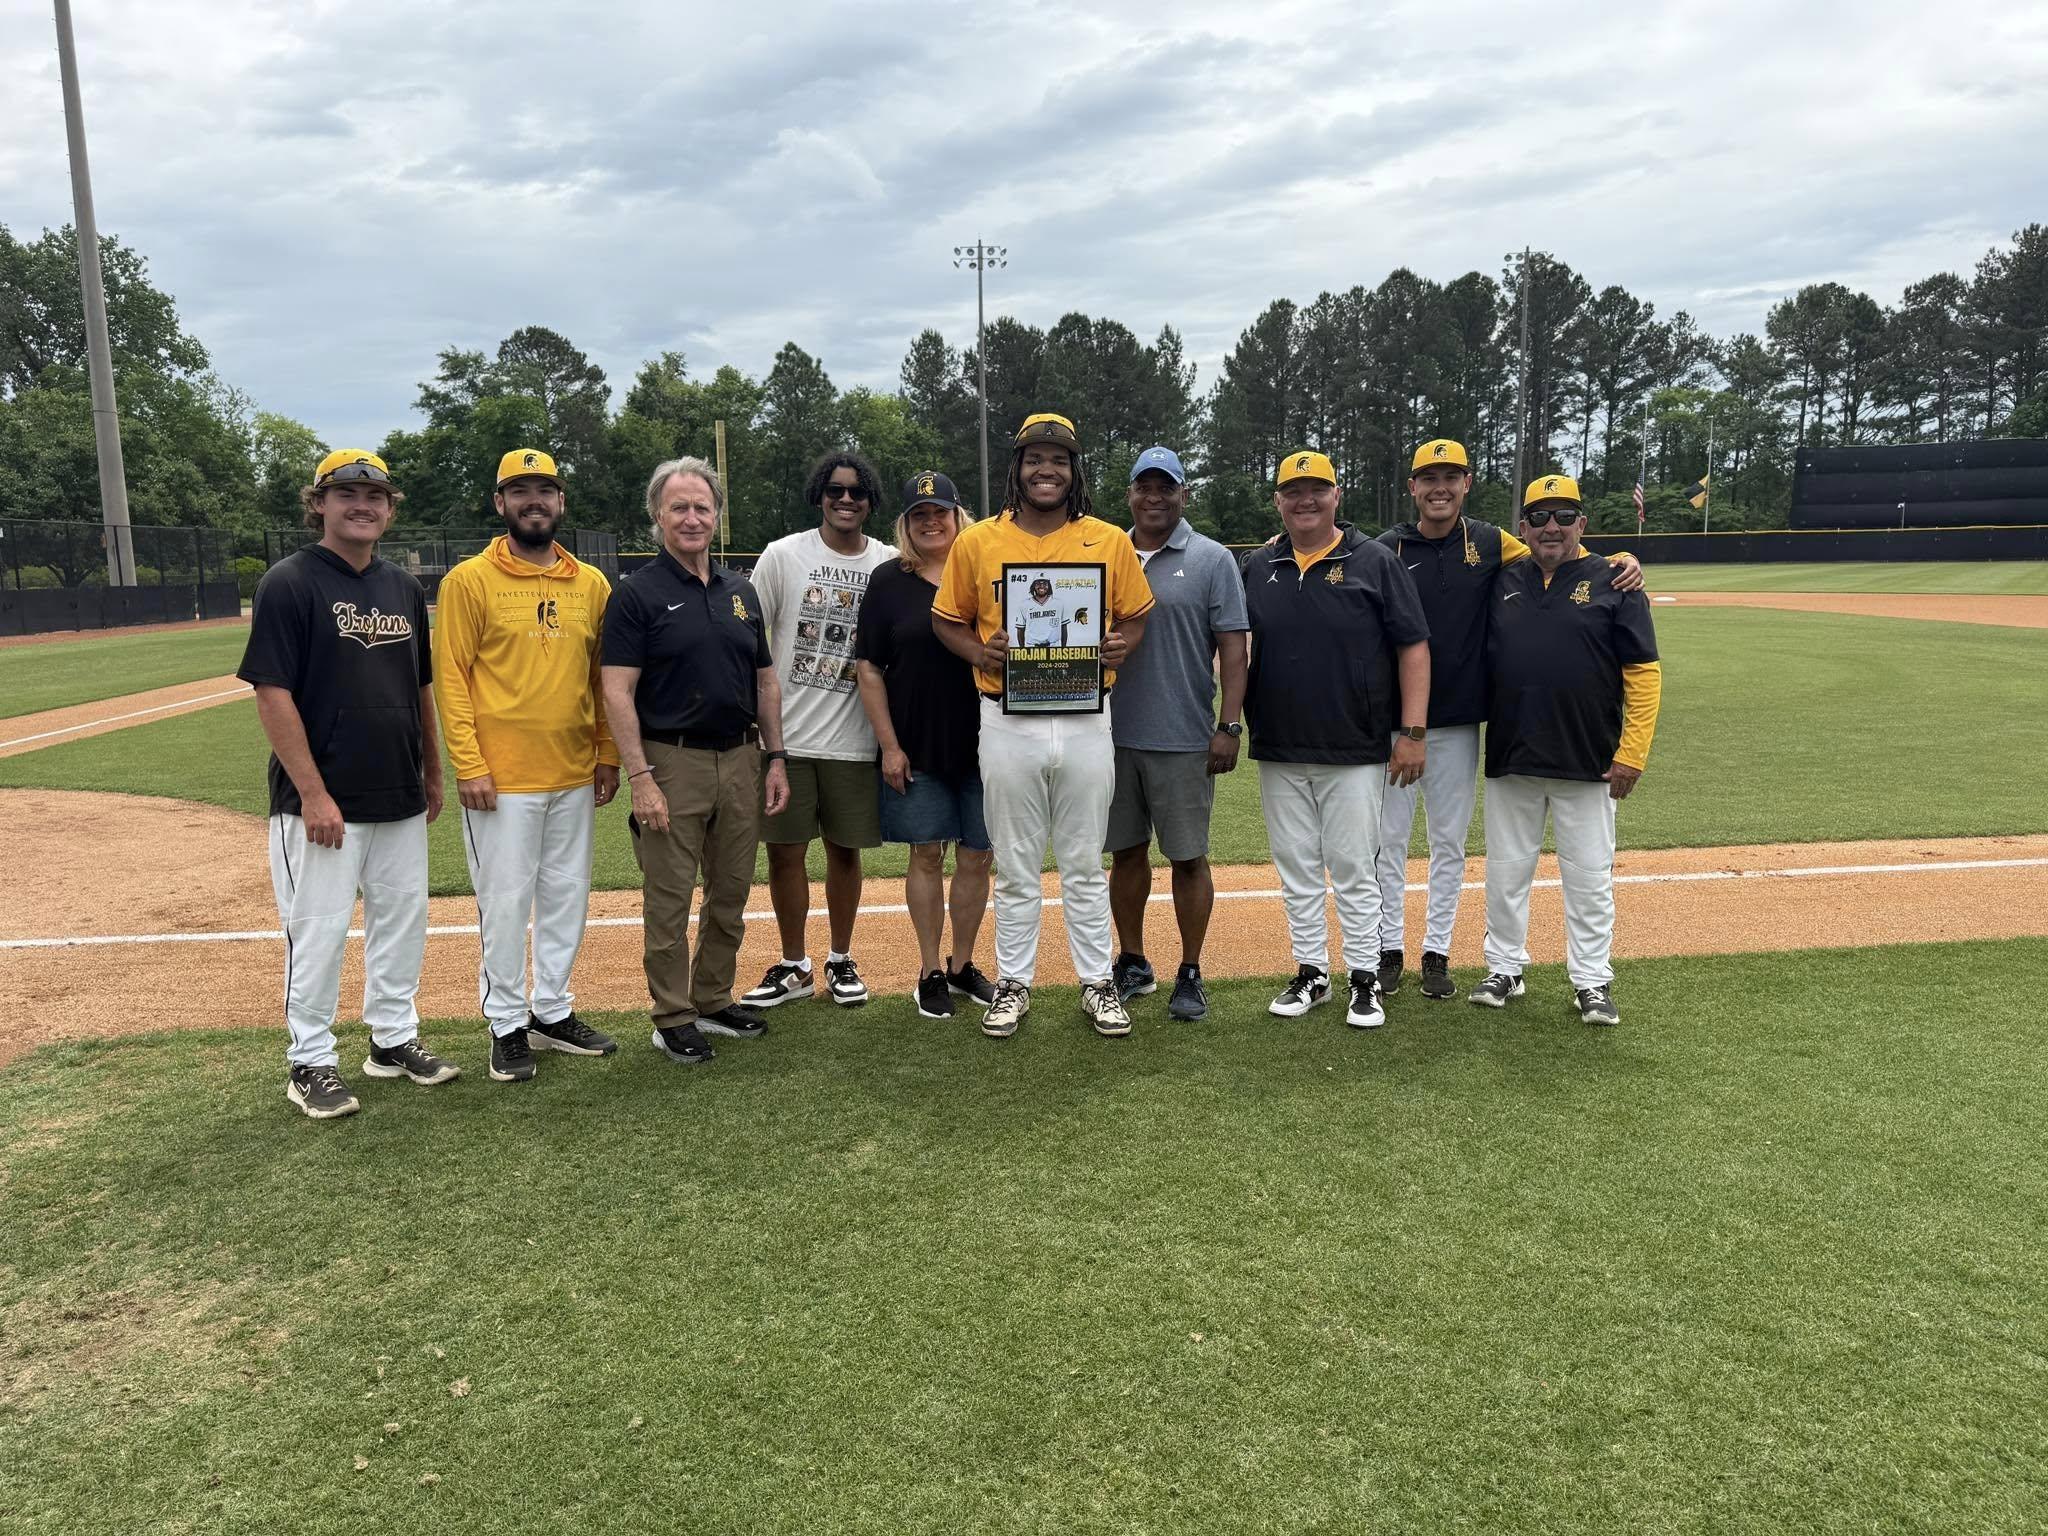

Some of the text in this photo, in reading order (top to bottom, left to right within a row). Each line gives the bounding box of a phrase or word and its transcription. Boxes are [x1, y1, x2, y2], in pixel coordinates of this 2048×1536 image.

[1011, 574, 1028, 583] #43
[333, 602, 412, 643] Trojans
[1010, 647, 1098, 661] TROJAN BASEBALL
